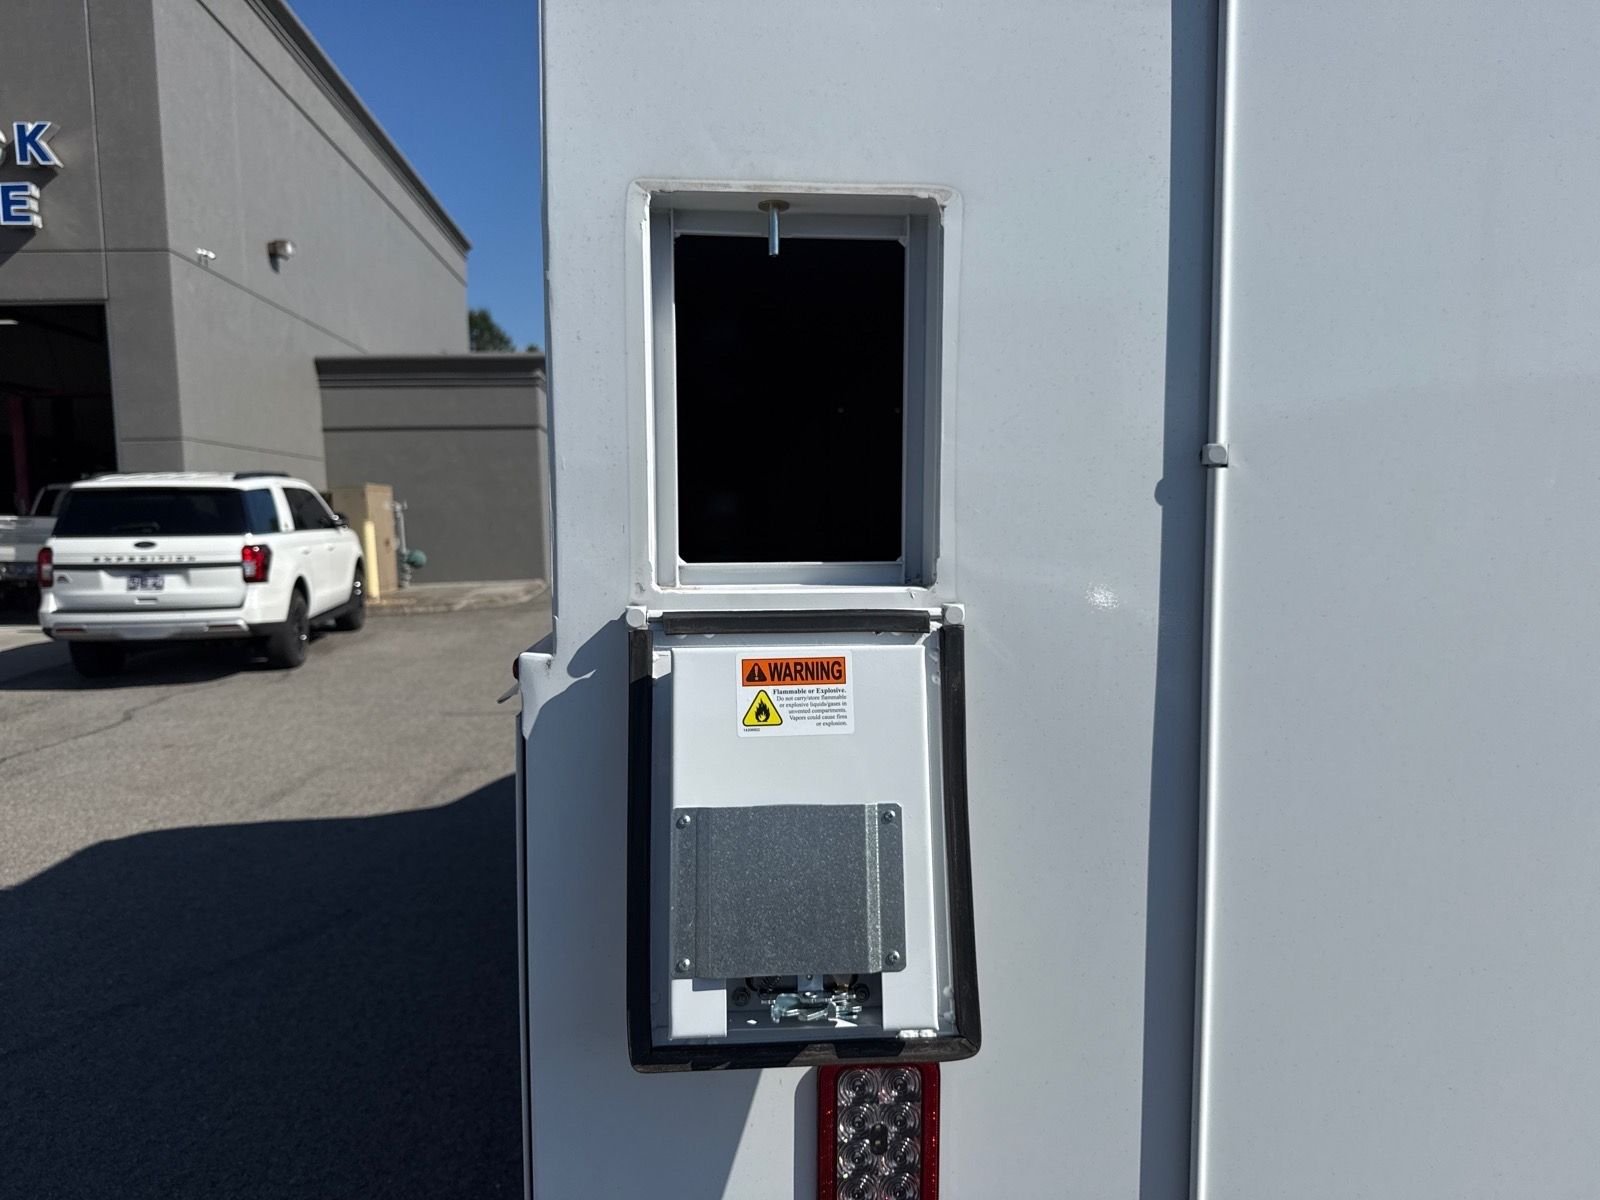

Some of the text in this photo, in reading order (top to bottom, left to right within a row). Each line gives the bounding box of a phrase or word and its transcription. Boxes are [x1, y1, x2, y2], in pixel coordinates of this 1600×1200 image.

[0, 121, 63, 168] K
[768, 661, 842, 681] WARNING
[816, 687, 847, 695] Explosive.
